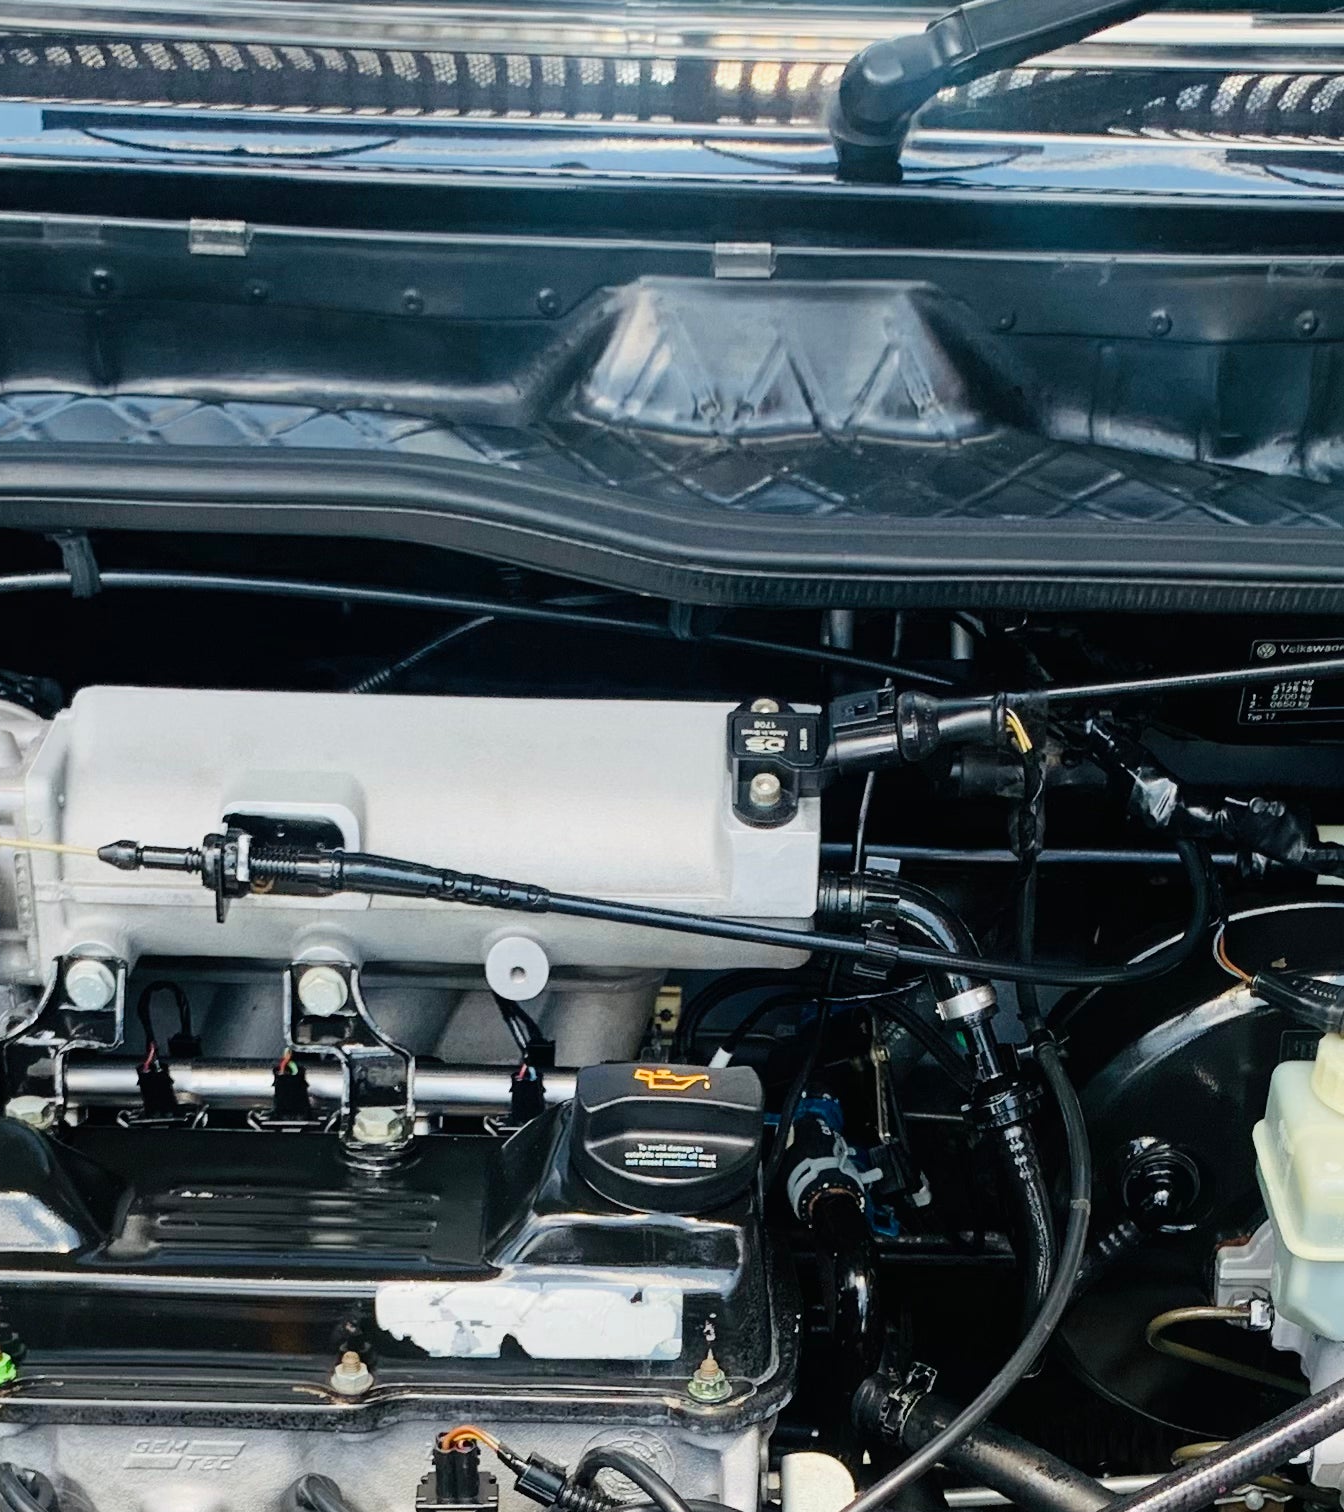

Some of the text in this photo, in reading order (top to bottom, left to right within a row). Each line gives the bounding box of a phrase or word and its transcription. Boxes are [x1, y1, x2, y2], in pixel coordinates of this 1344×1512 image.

[637, 1143, 647, 1152] To
[647, 1144, 667, 1152] avoid
[184, 1455, 236, 1471] TEC
